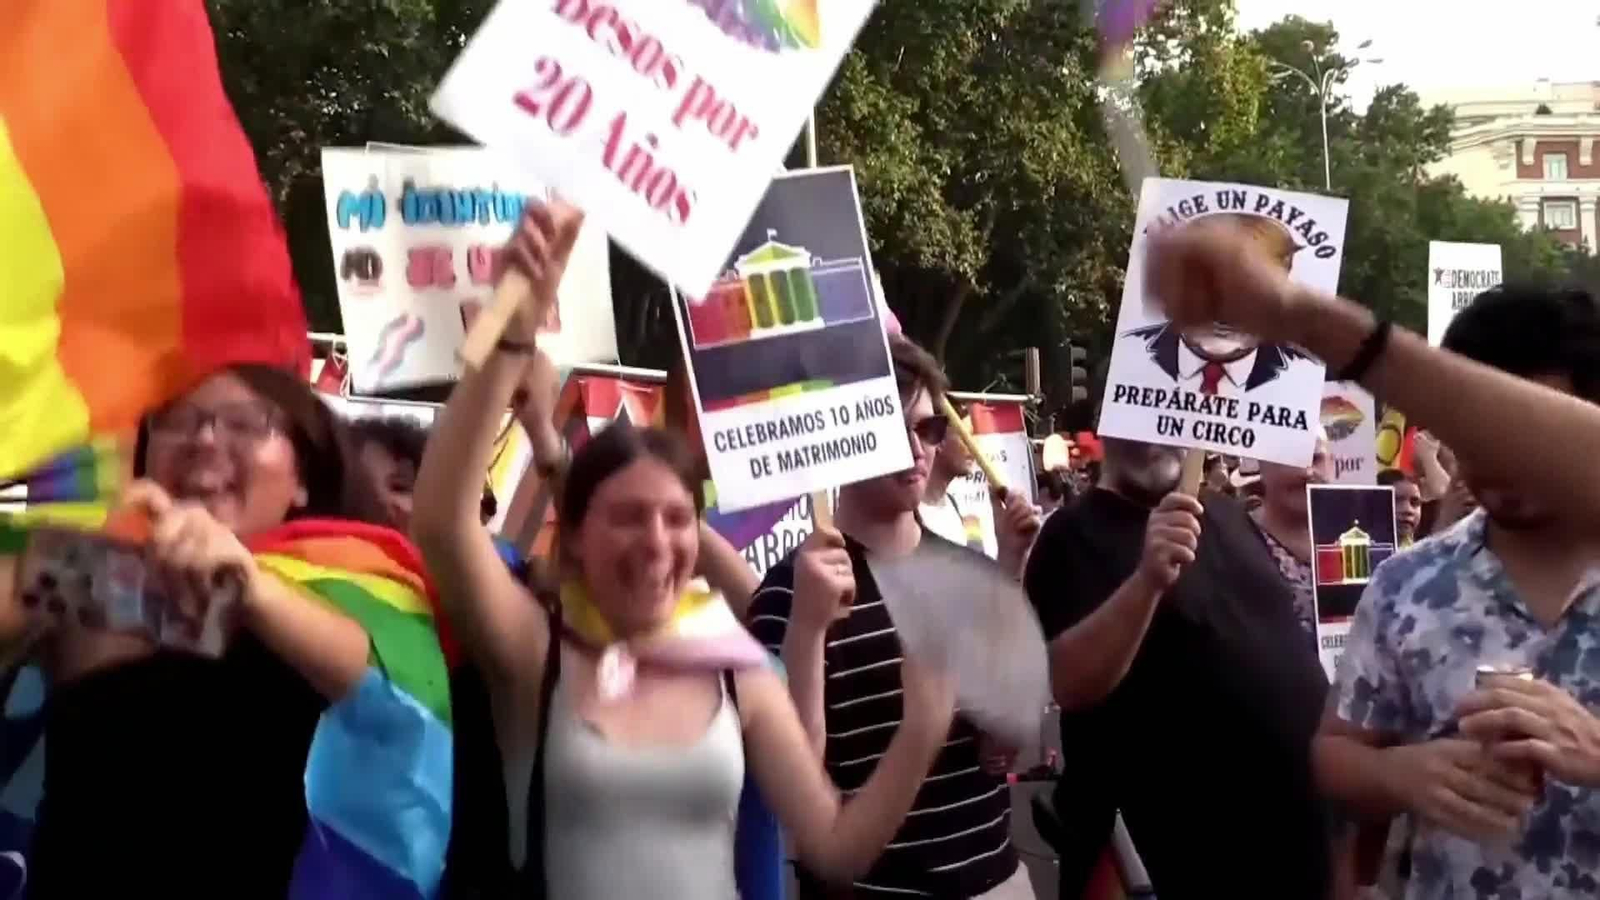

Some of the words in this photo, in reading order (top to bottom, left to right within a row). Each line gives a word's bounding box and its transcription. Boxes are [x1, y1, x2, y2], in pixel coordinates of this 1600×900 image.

[512, 55, 594, 138] 20
[600, 110, 699, 226] Años
[671, 74, 760, 153] por
[1144, 195, 1209, 234] LIGE
[1216, 190, 1248, 211] UN
[1253, 194, 1337, 260] PAYASO
[713, 409, 827, 454] CELEBRAMOS
[832, 404, 851, 426] 10
[854, 395, 895, 422] AÑOS
[1112, 384, 1240, 420] PREPÁRATE
[1245, 403, 1309, 431] PARA
[1156, 415, 1185, 437] UN
[1192, 420, 1256, 449] CIRCO
[749, 455, 773, 480] DE
[777, 431, 878, 472] MATRIMONIO
[1334, 457, 1364, 480] por
